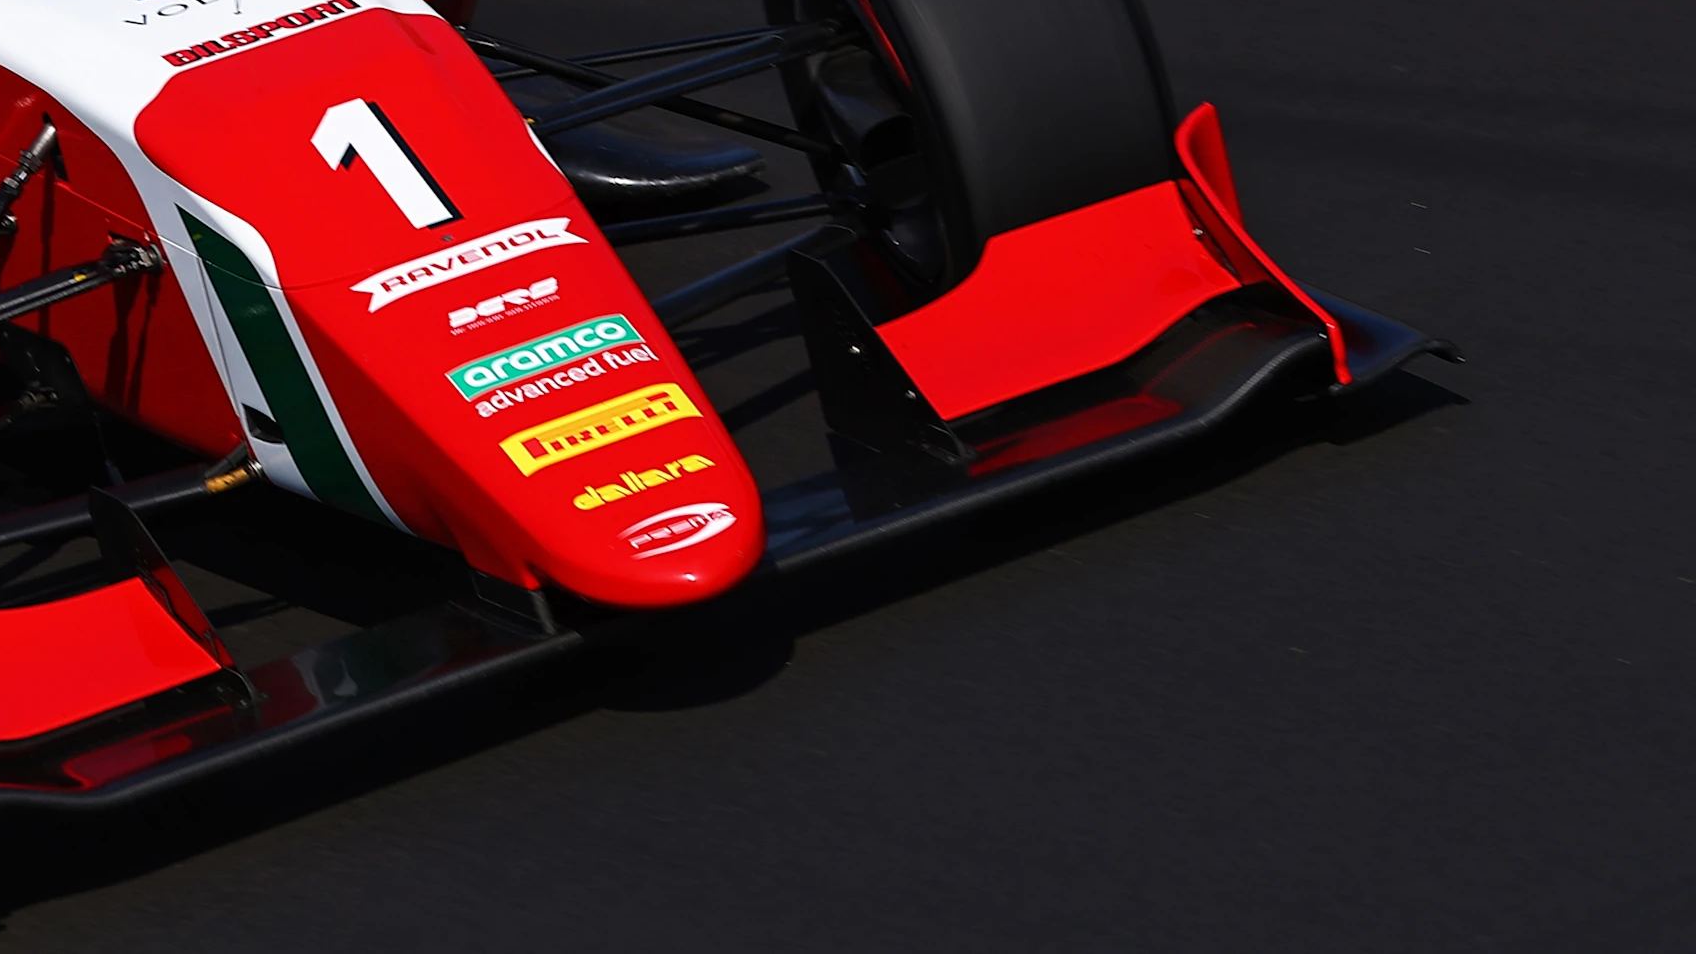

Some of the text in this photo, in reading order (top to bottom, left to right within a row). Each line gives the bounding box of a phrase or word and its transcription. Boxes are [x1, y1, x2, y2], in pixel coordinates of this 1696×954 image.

[310, 97, 464, 230] 1
[380, 229, 561, 292] RAVENOL
[463, 321, 628, 388] aramco
[475, 344, 660, 418] advanced fuel
[521, 391, 679, 460] PIRELLI
[572, 454, 716, 511] dallara
